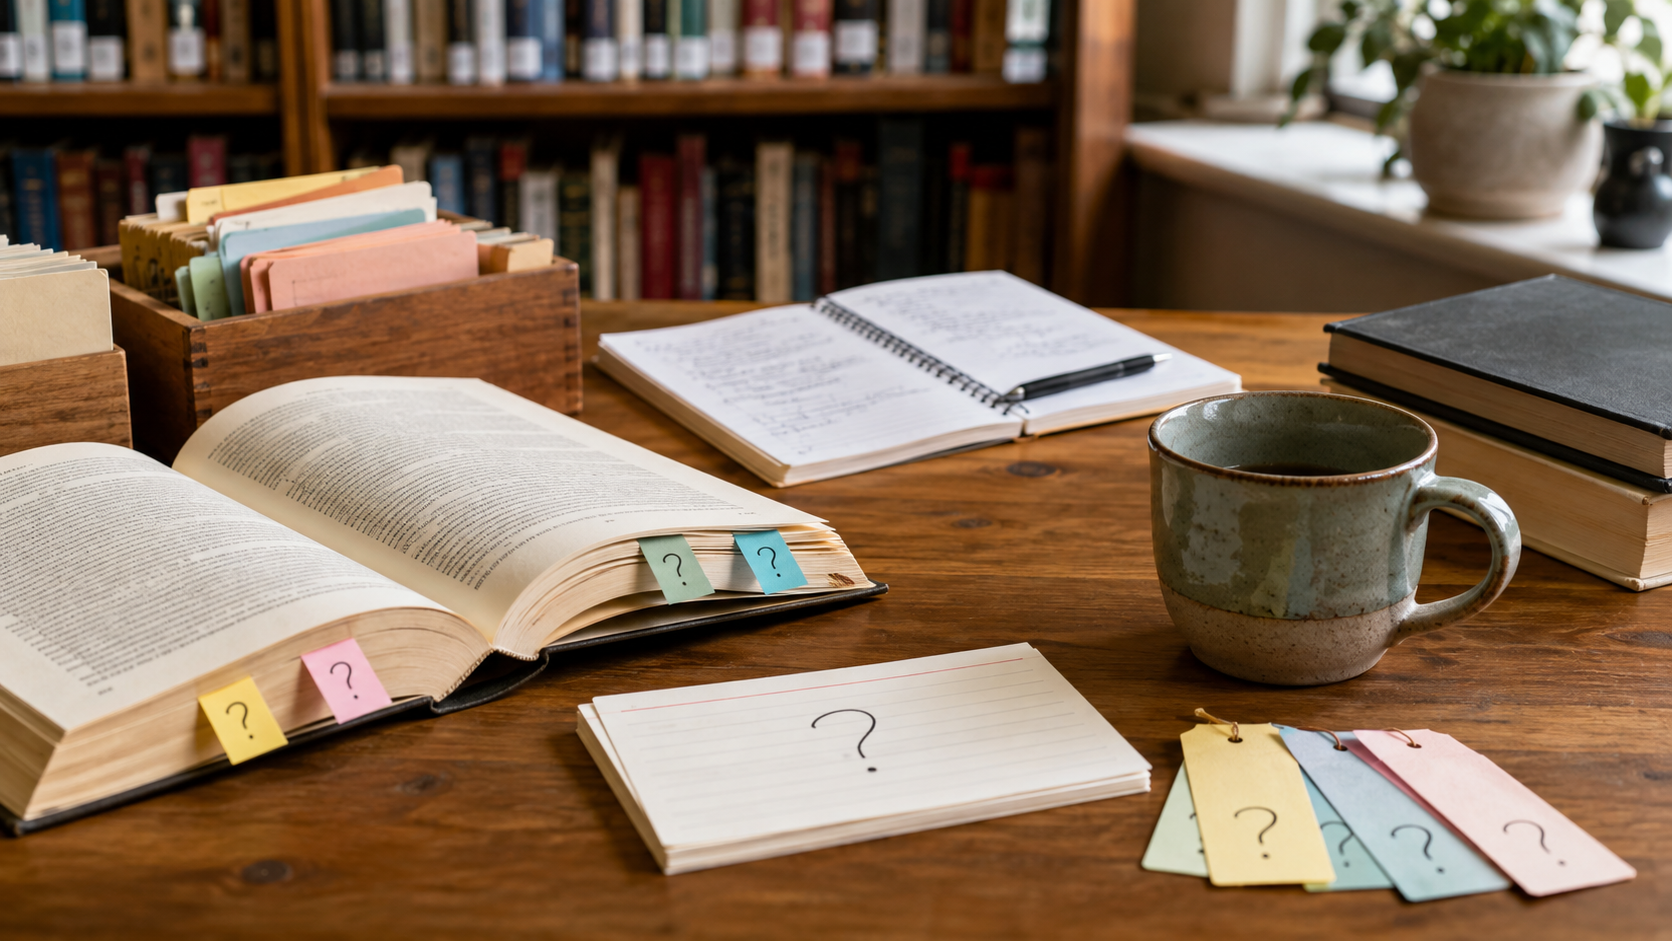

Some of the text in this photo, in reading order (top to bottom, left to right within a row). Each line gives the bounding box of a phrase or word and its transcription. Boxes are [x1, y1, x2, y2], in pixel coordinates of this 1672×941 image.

[662, 553, 687, 586] ?
[757, 546, 781, 577] ?
[329, 660, 359, 700] ?
[225, 700, 255, 740] ?
[811, 708, 878, 773] ?
[1234, 807, 1277, 859] ?
[1390, 823, 1446, 874] ?
[1503, 820, 1567, 867] ?
